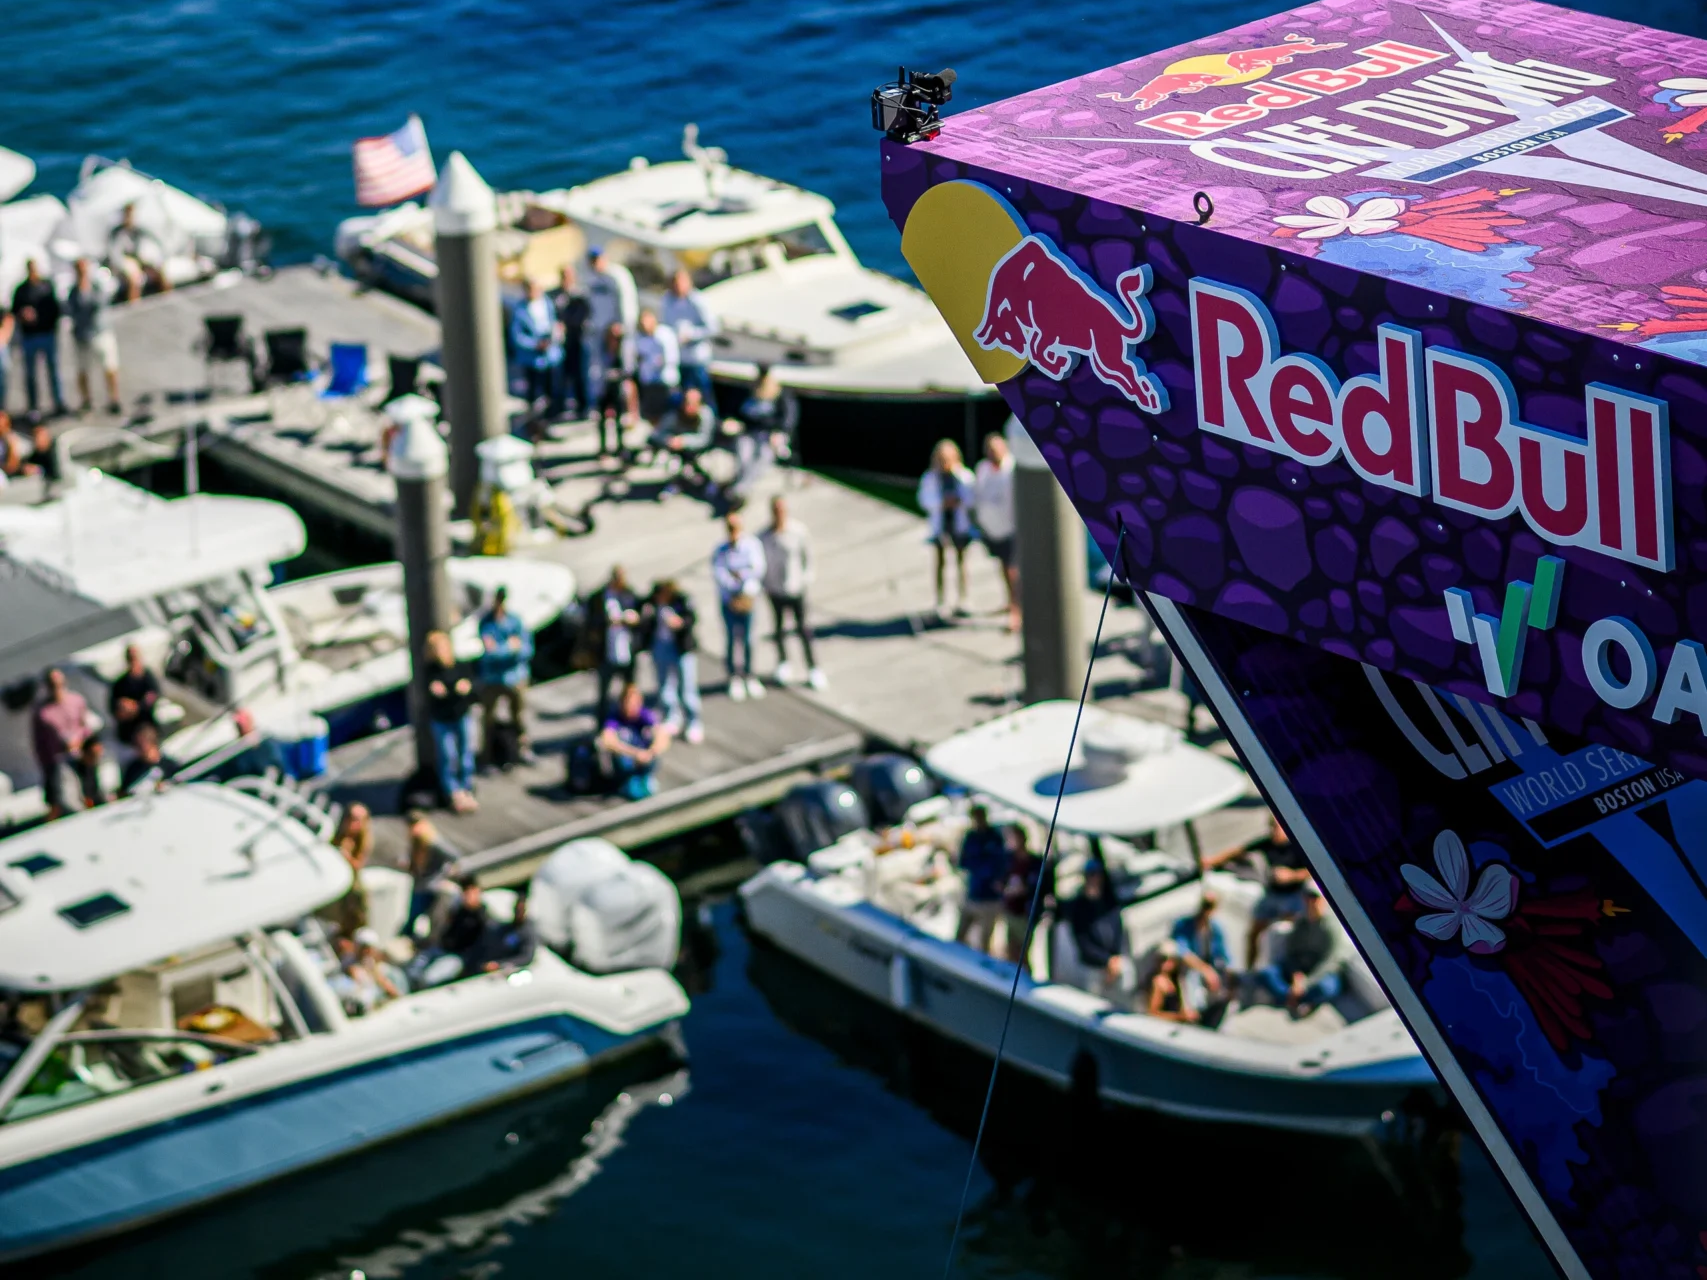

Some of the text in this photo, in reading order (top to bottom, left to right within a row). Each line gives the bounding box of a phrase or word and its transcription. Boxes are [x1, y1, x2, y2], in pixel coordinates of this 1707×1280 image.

[1189, 51, 1617, 179] CLIFF DIVING
[1372, 99, 1607, 178] WORLD SERIES 2025
[1472, 130, 1568, 163] BOSTON USA
[1503, 761, 1588, 815] WORLD
[1592, 767, 1685, 814] BOSTON USA
